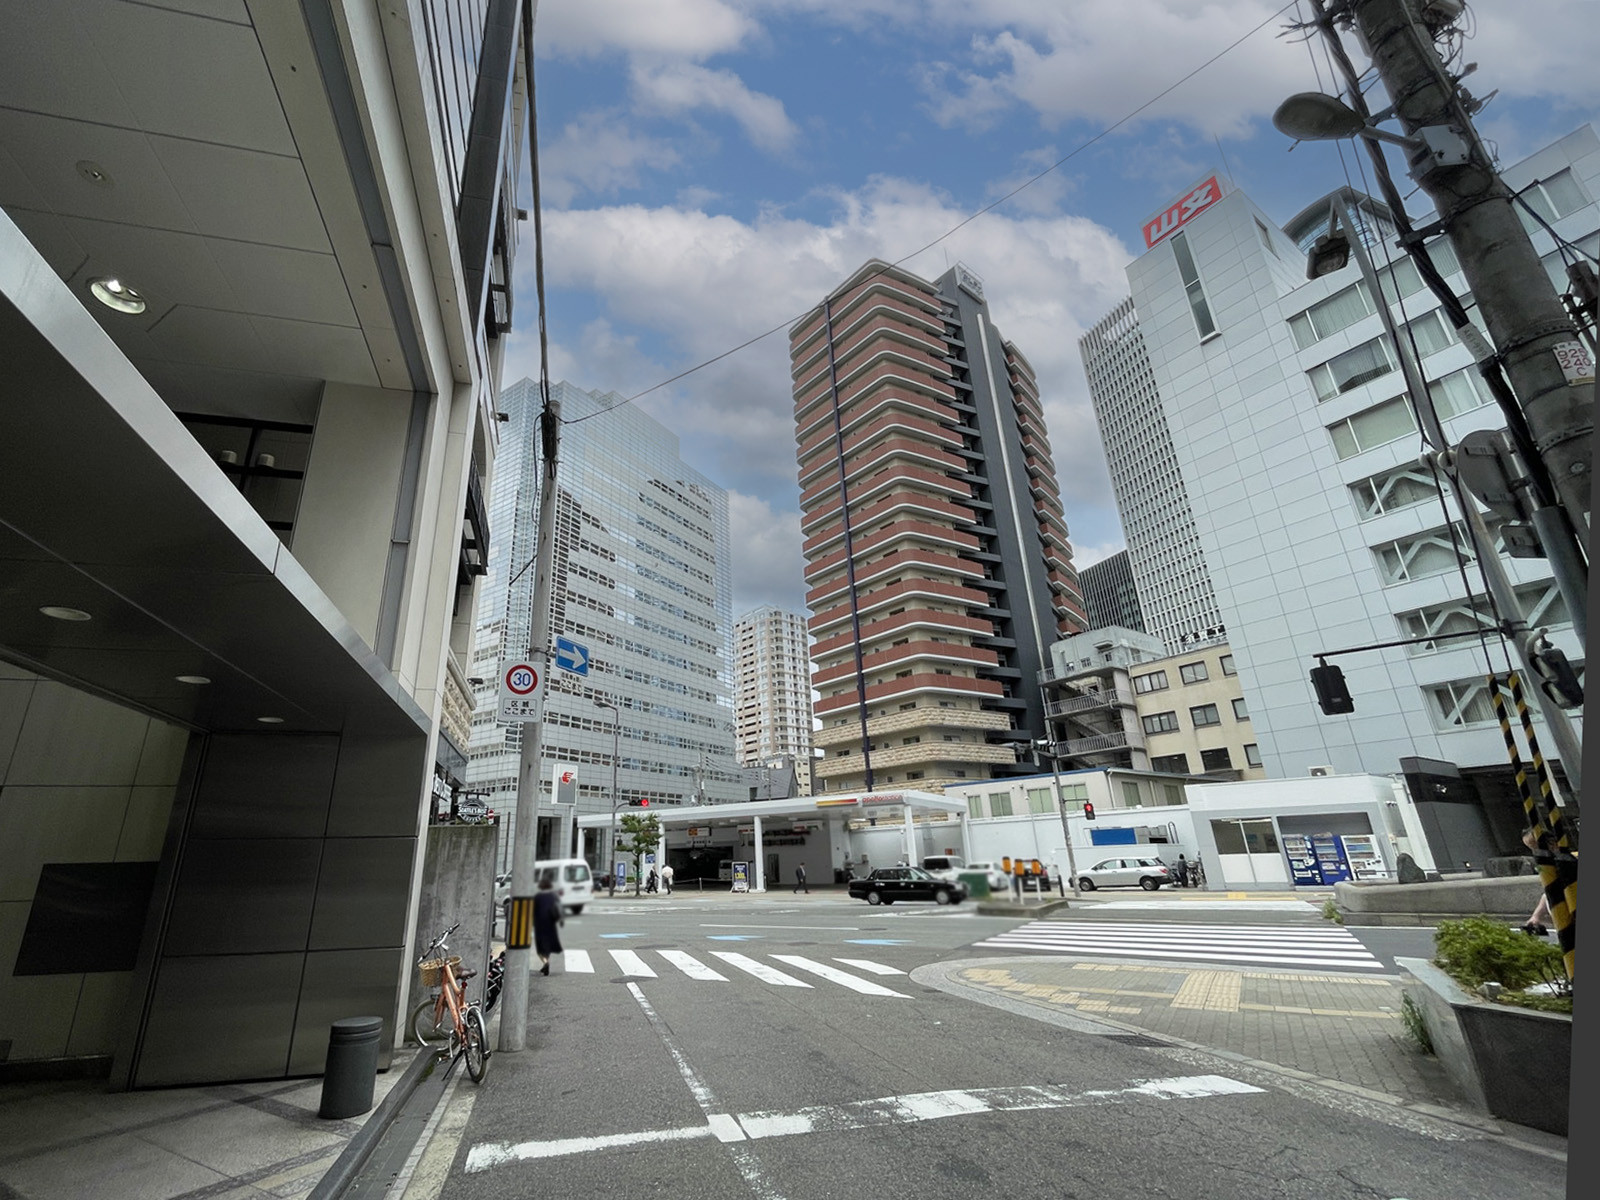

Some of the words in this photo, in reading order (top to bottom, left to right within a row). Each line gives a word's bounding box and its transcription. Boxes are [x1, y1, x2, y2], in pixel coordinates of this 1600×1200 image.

[1561, 357, 1592, 369] 240
[1576, 367, 1587, 376] C
[513, 672, 531, 686] 30
[504, 707, 534, 715] ここまで
